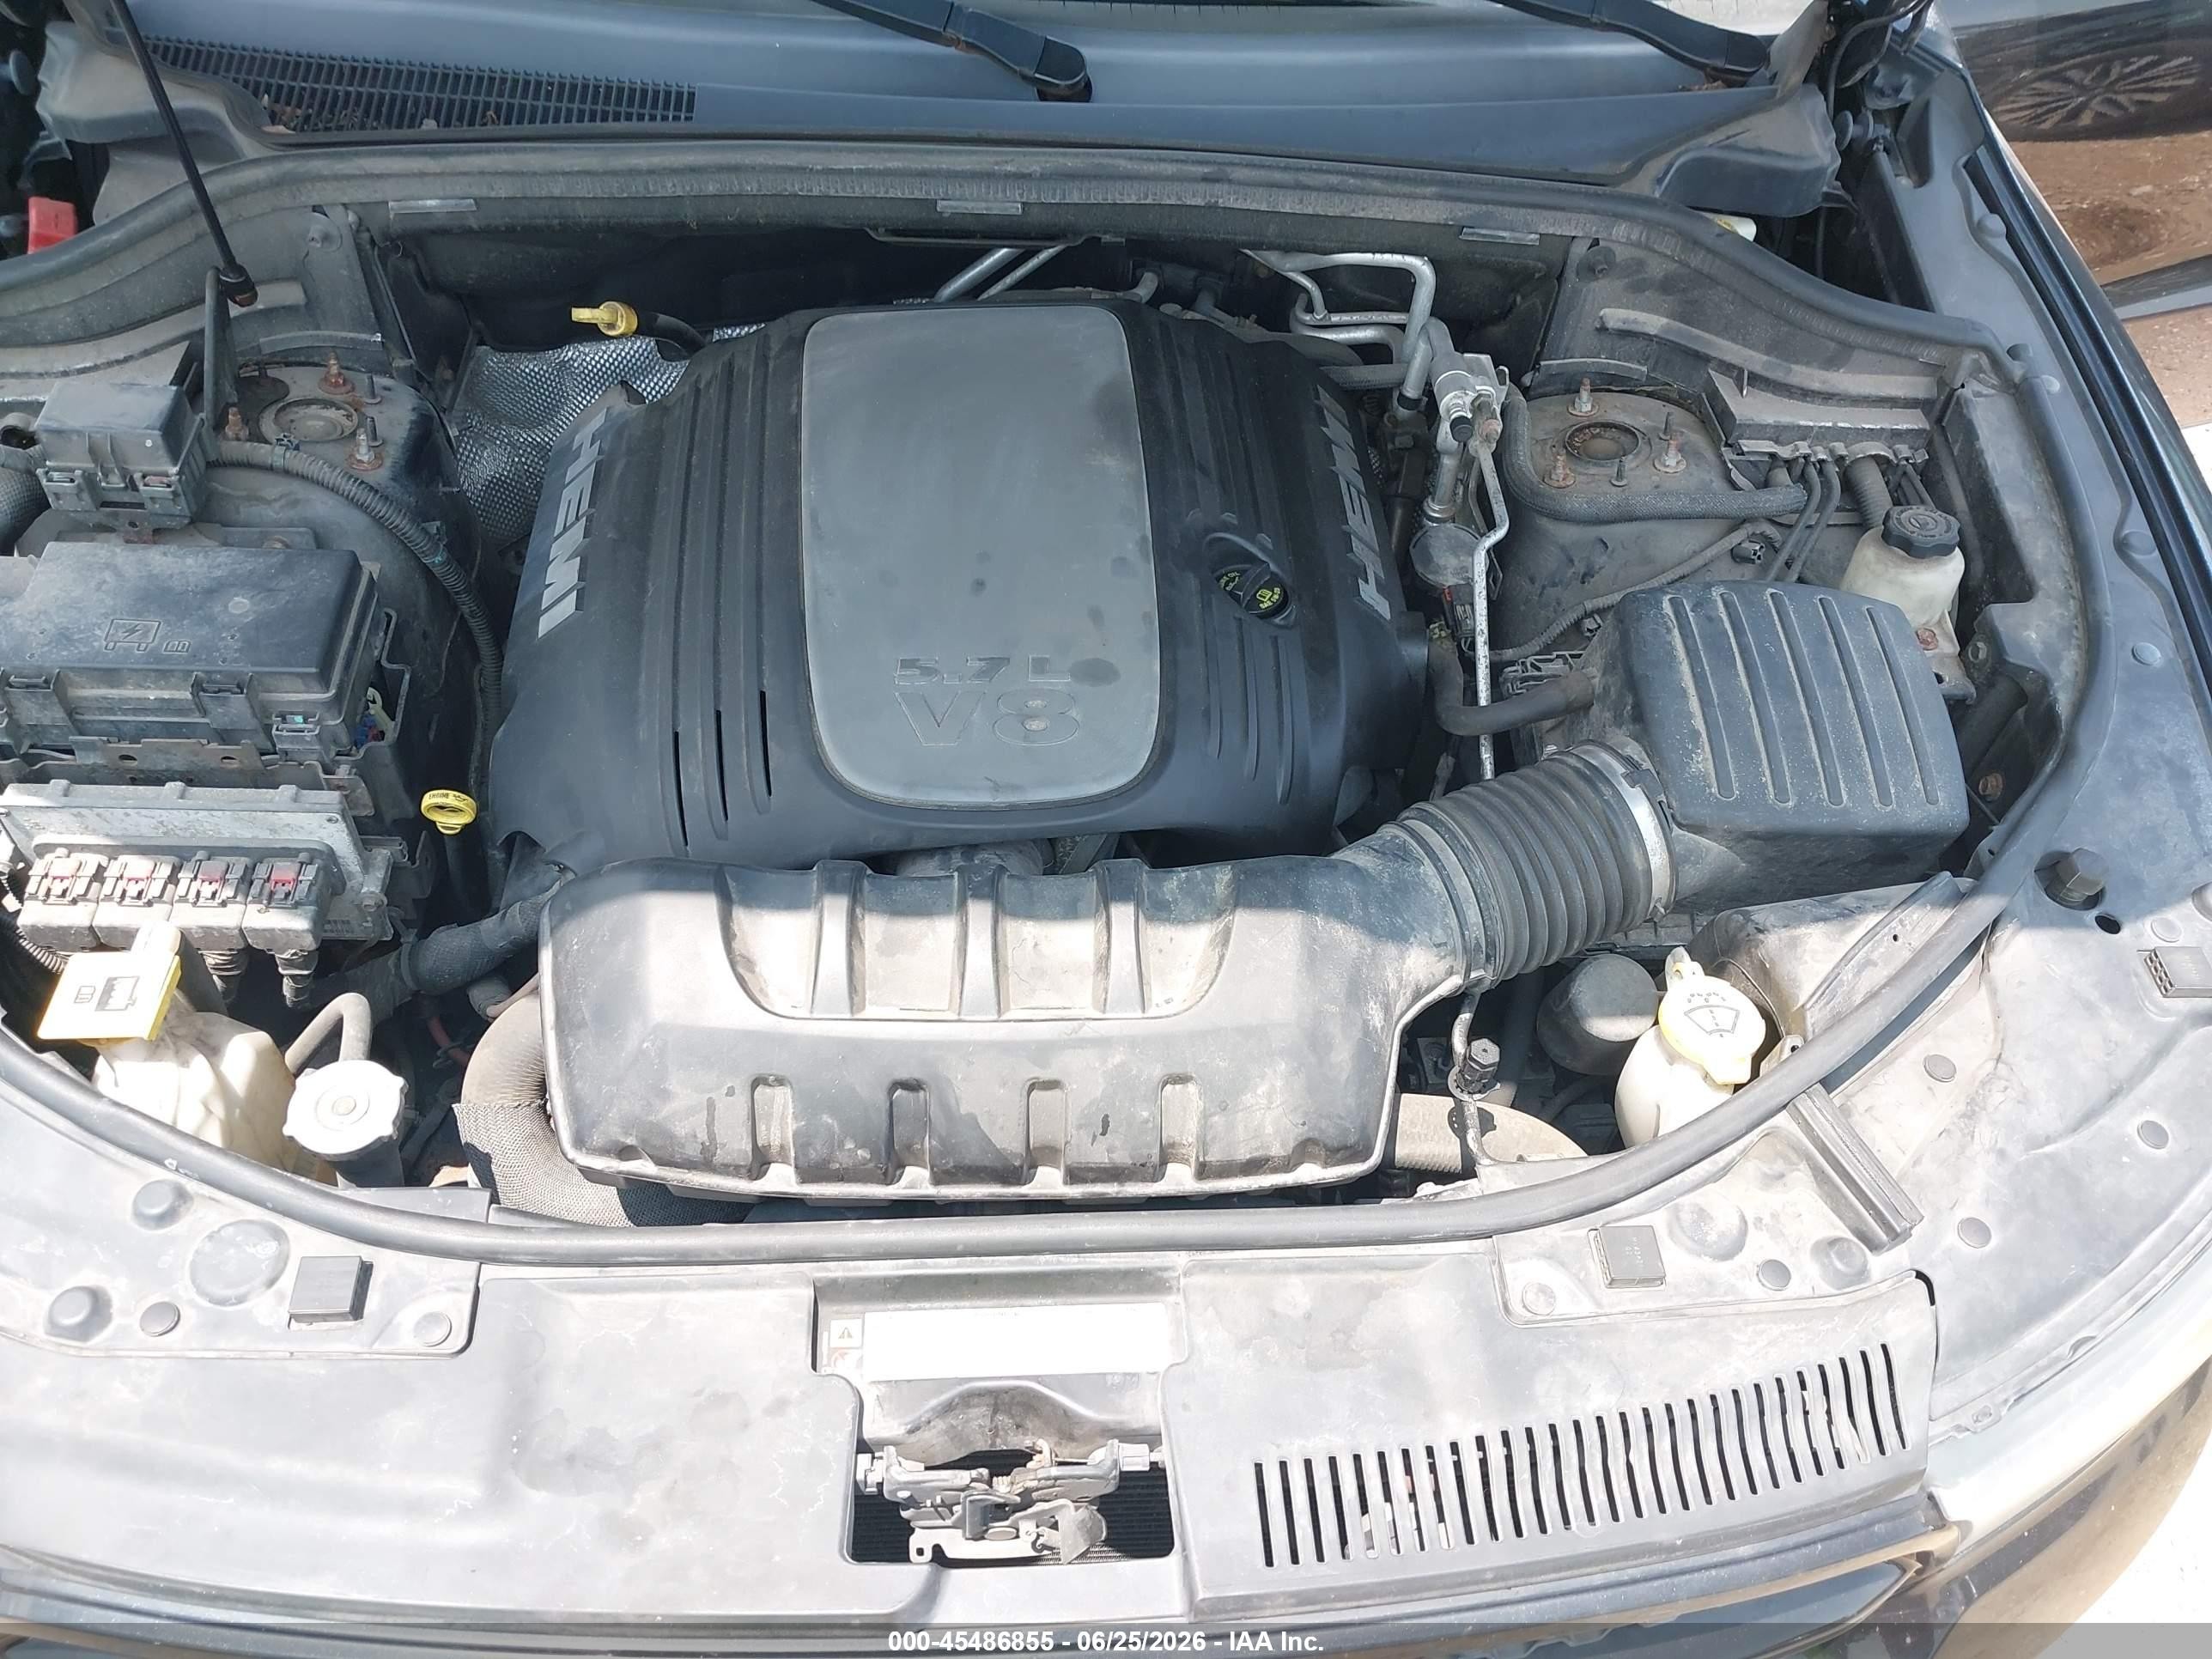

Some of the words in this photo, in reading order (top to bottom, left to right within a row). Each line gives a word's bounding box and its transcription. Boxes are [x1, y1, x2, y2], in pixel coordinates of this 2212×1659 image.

[538, 407, 607, 639] HEMI
[1316, 384, 1391, 620] HEMI
[893, 688, 1080, 746] V8
